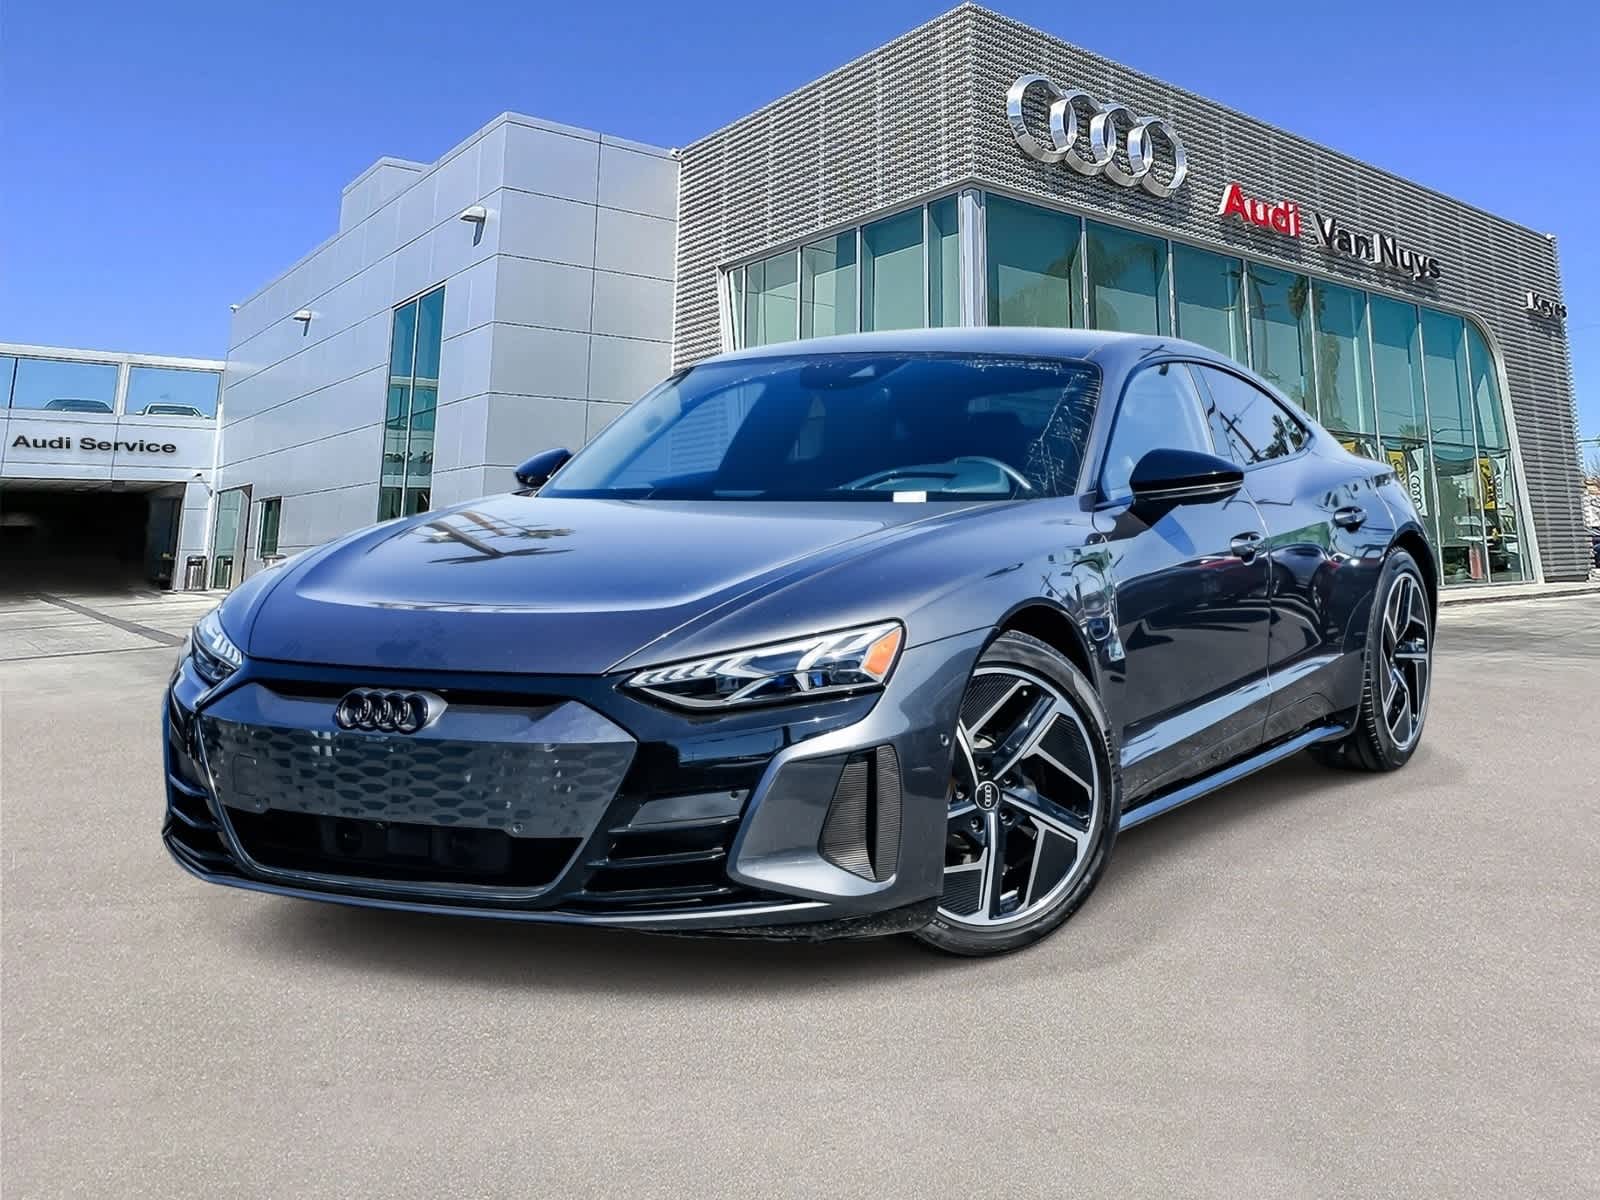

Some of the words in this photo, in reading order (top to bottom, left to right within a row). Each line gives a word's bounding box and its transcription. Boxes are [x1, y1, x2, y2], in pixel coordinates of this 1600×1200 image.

[1218, 182, 1301, 238] Audi
[1311, 211, 1371, 259] Van
[1374, 232, 1442, 281] Nuys
[1526, 292, 1568, 320] Keyes
[12, 435, 71, 449] Audi
[79, 437, 177, 453] Service
